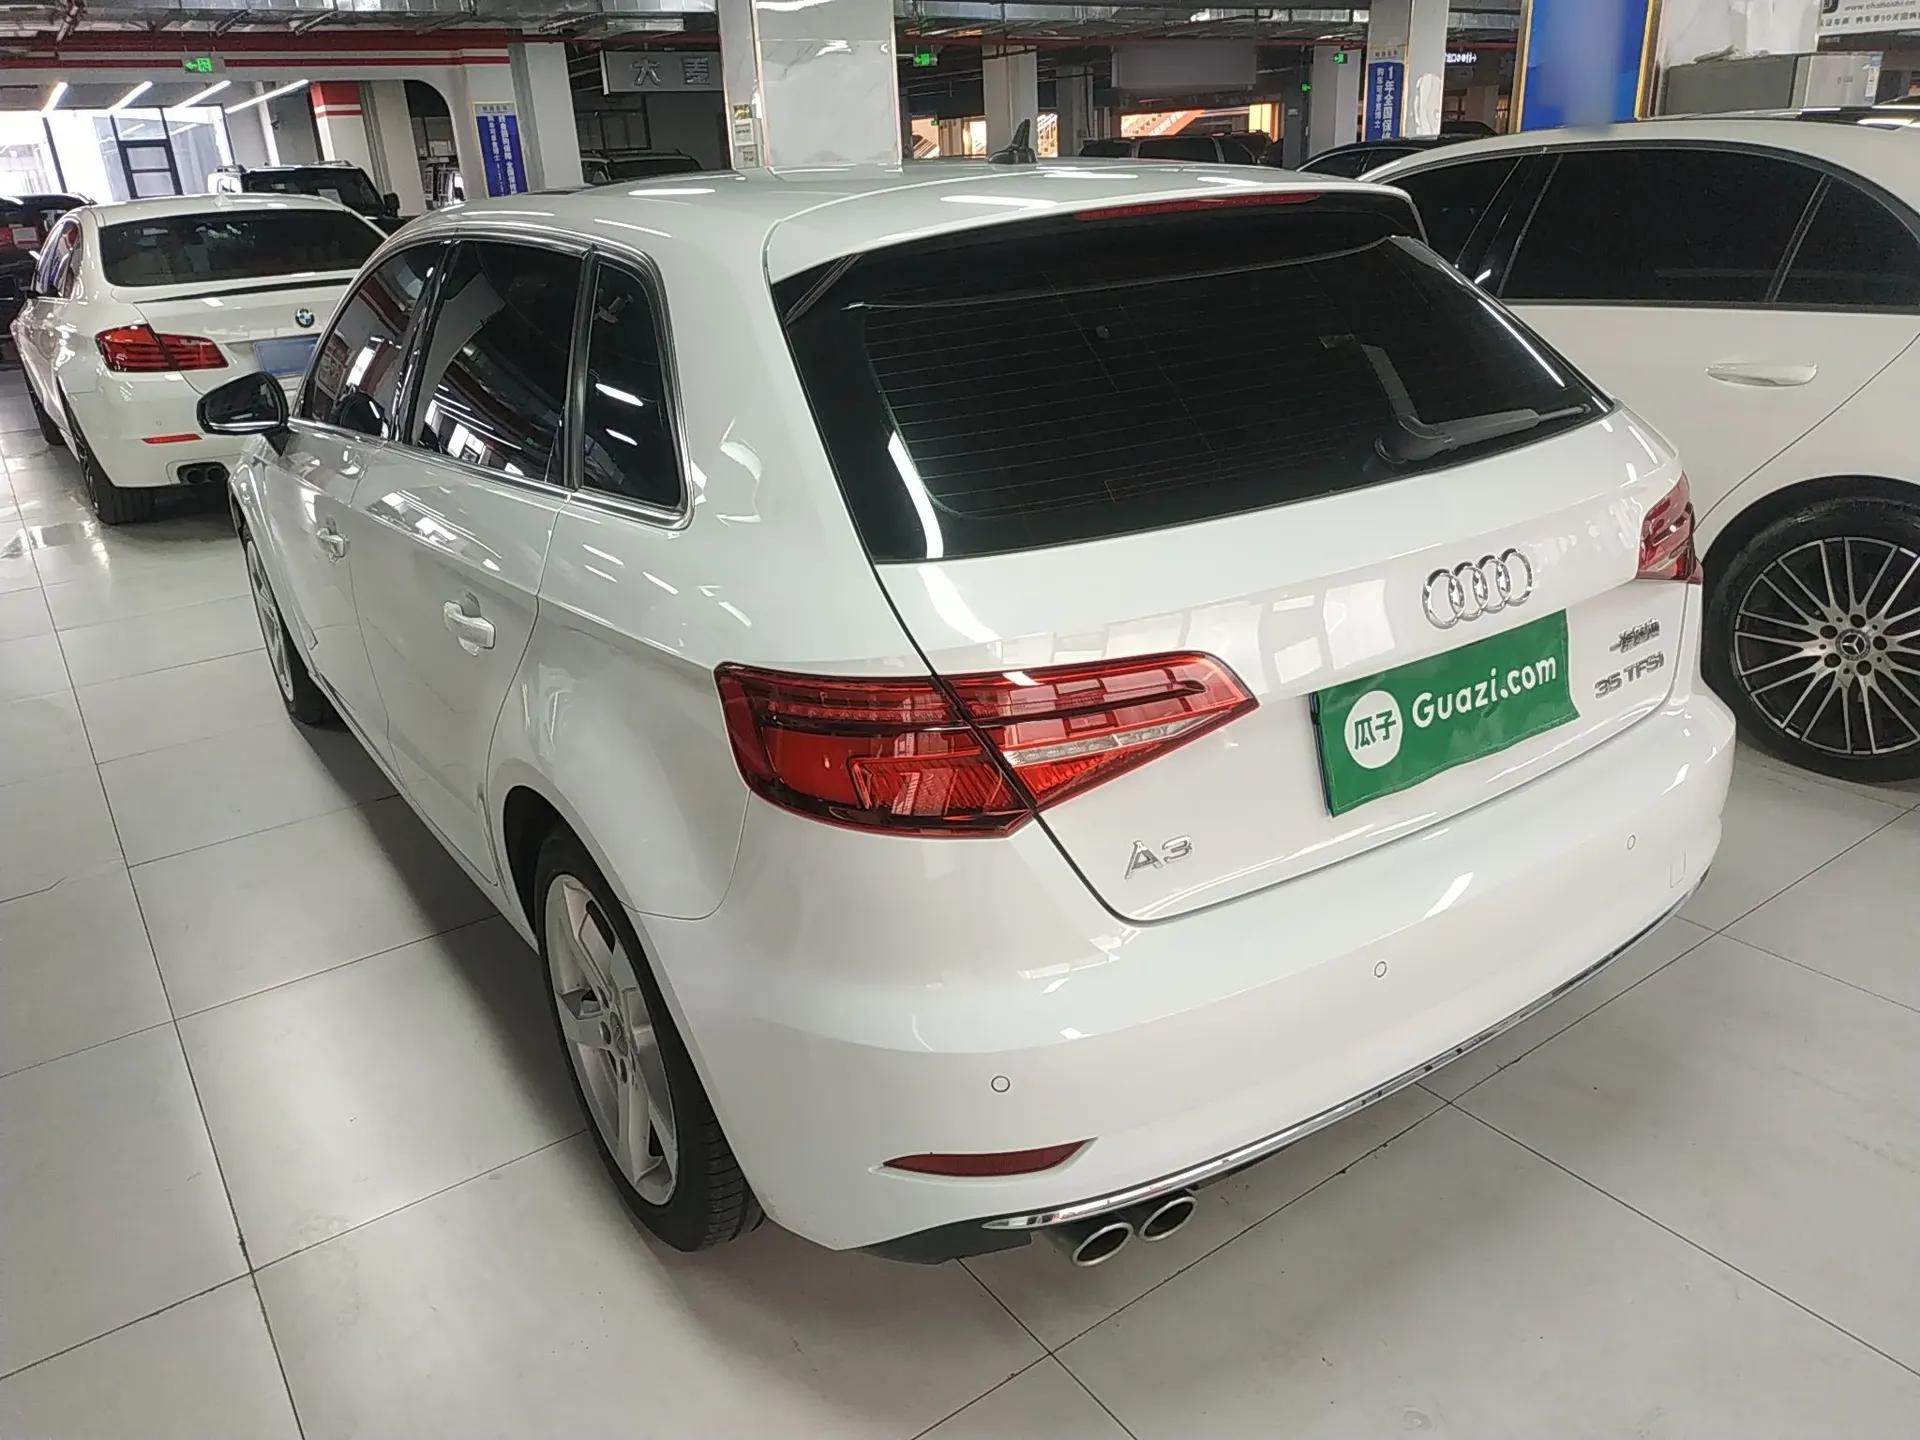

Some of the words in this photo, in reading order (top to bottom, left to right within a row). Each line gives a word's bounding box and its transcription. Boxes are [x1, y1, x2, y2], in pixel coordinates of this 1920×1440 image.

[1411, 656, 1557, 729] Guazi.com
[1594, 672, 1623, 699] 35
[1623, 651, 1665, 682] TFSI
[1353, 709, 1397, 750] 瓜子
[1124, 835, 1193, 880] A3
